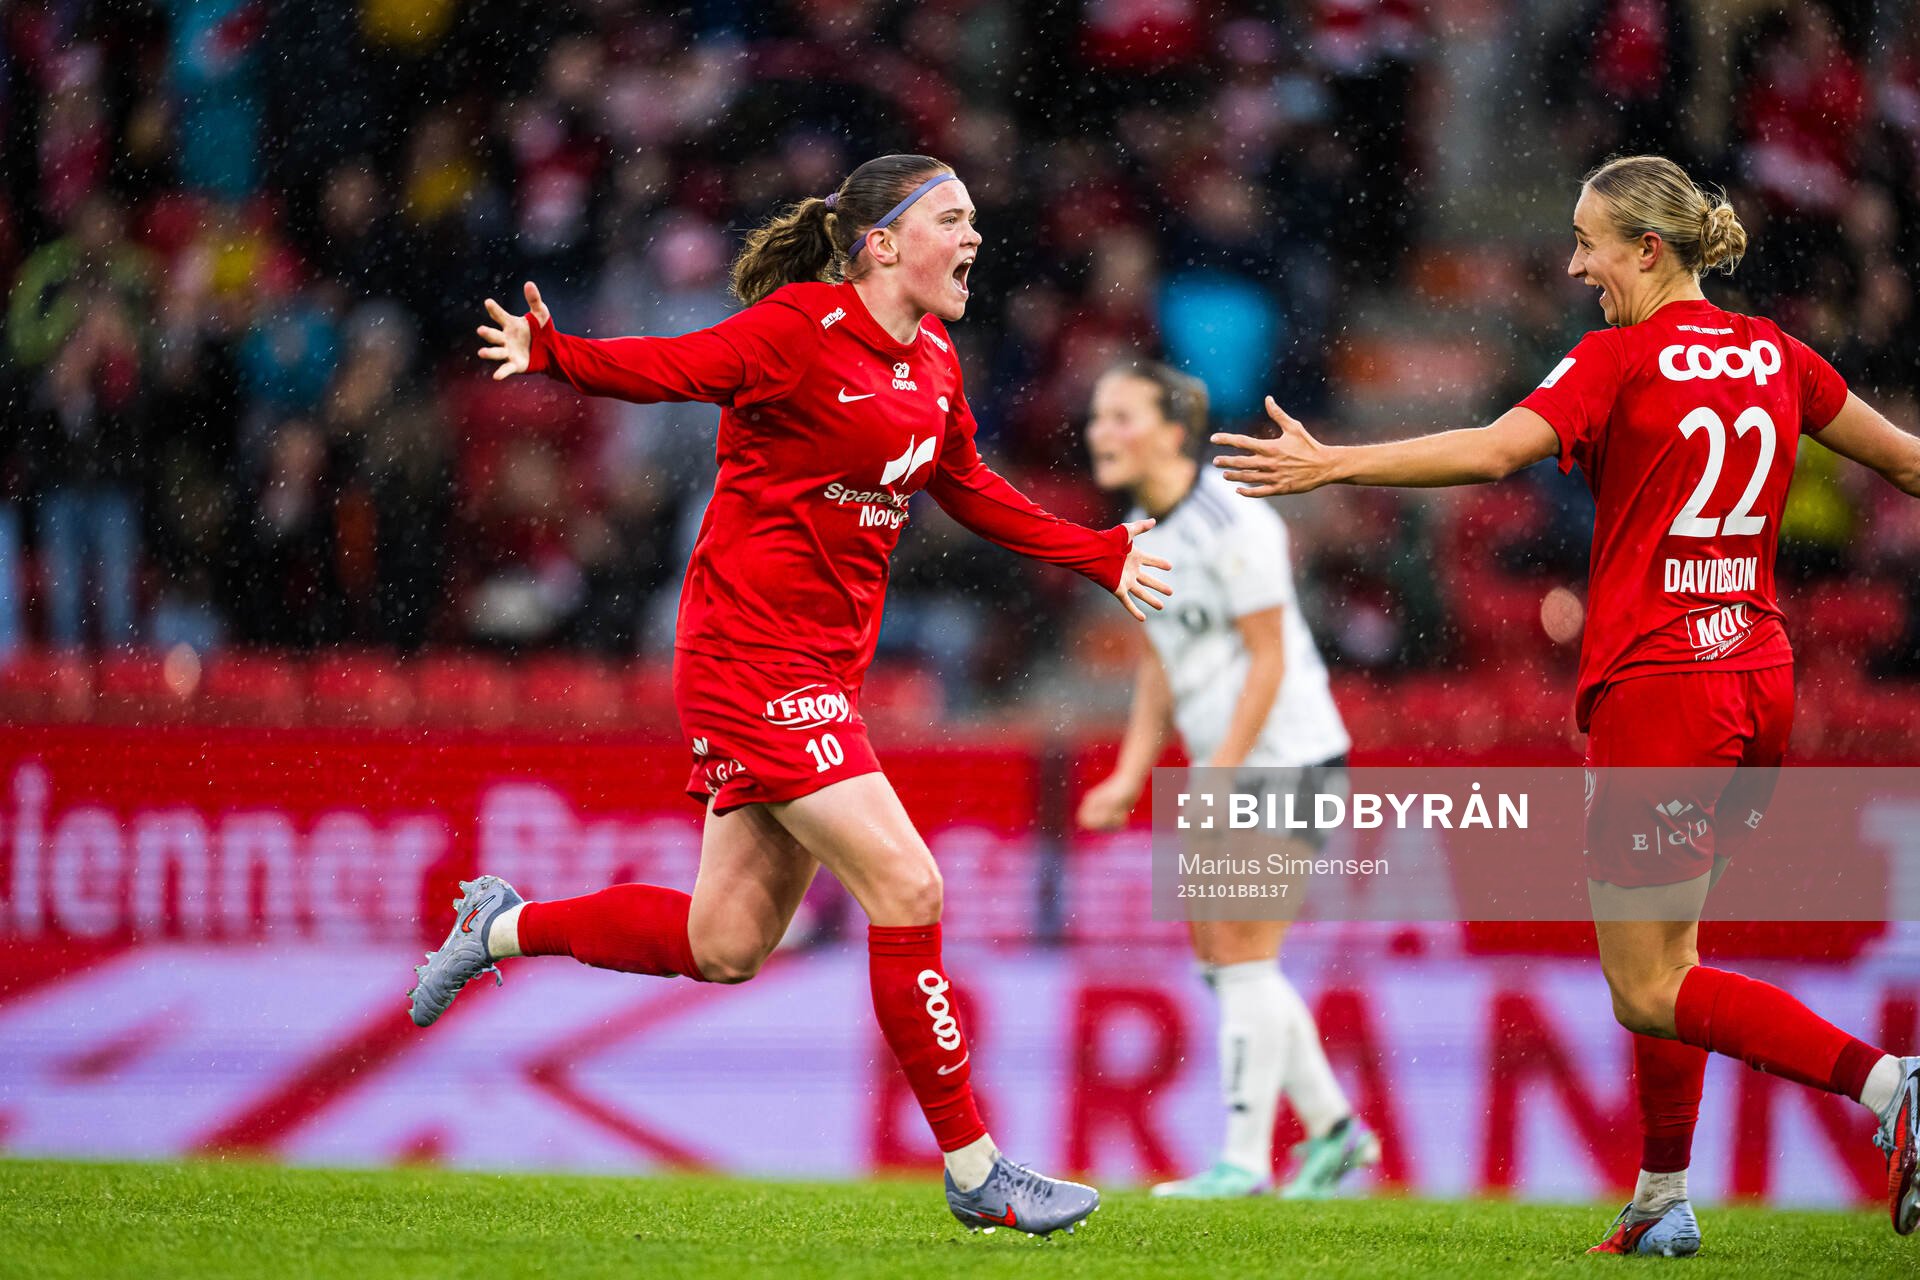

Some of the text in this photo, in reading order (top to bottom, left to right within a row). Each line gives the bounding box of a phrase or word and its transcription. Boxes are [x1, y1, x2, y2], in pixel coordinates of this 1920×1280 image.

[1658, 340, 1782, 385] coop
[1668, 406, 1777, 537] 22
[1664, 557, 1757, 593] DAVIDSON
[1696, 603, 1749, 647] MOT
[805, 733, 845, 773] 10
[916, 969, 961, 1051] coop
